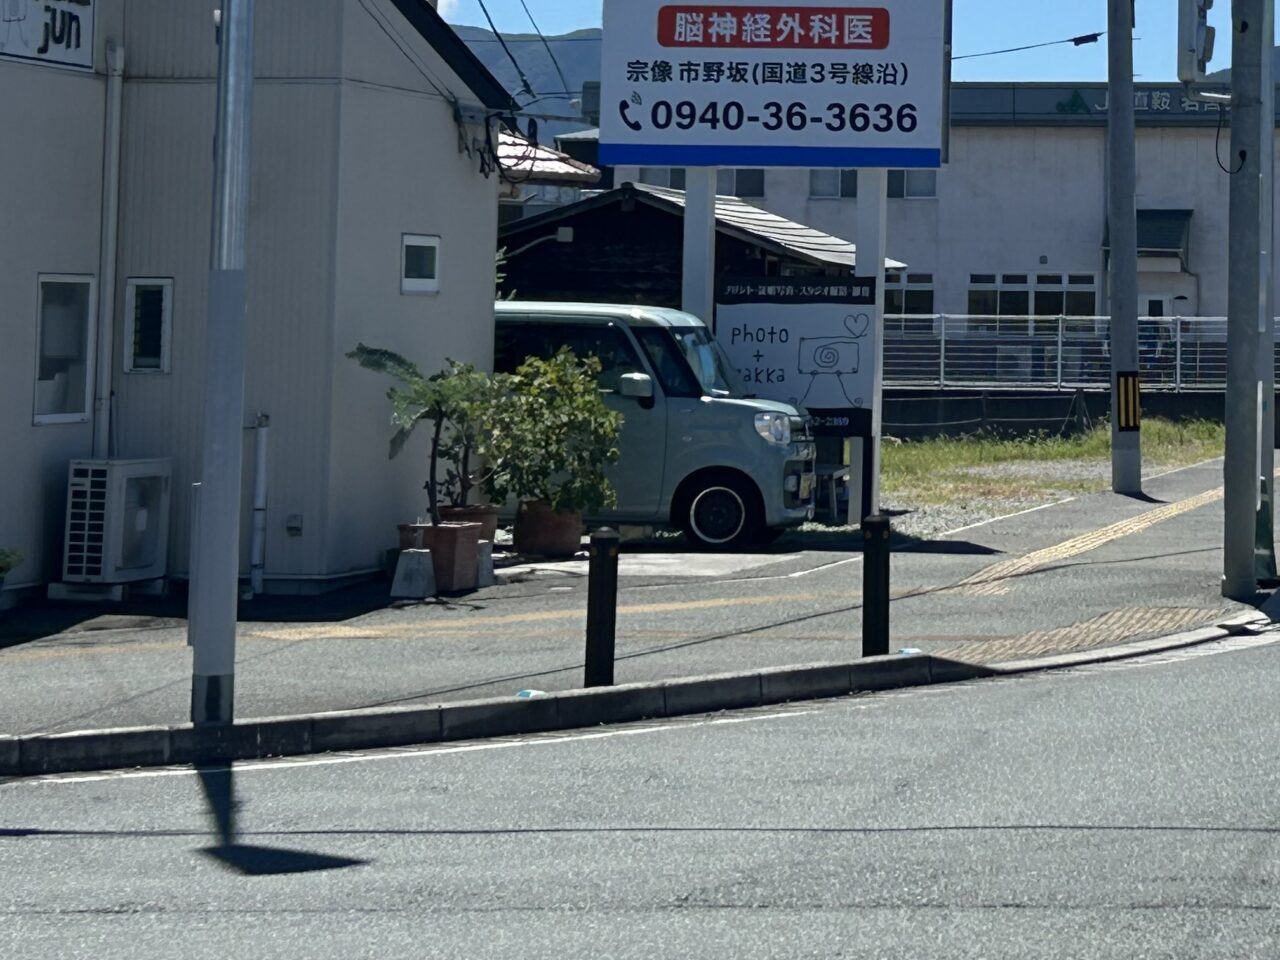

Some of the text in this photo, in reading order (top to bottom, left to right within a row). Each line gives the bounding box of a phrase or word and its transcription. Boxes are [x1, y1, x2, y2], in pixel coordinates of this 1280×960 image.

[37, 6, 80, 53] jun
[674, 12, 874, 44] 脳神経外科医
[626, 60, 910, 86] 宗像市野坂(国道3号線沿)
[651, 100, 919, 133] 0940-36-3636
[731, 324, 789, 344] photo
